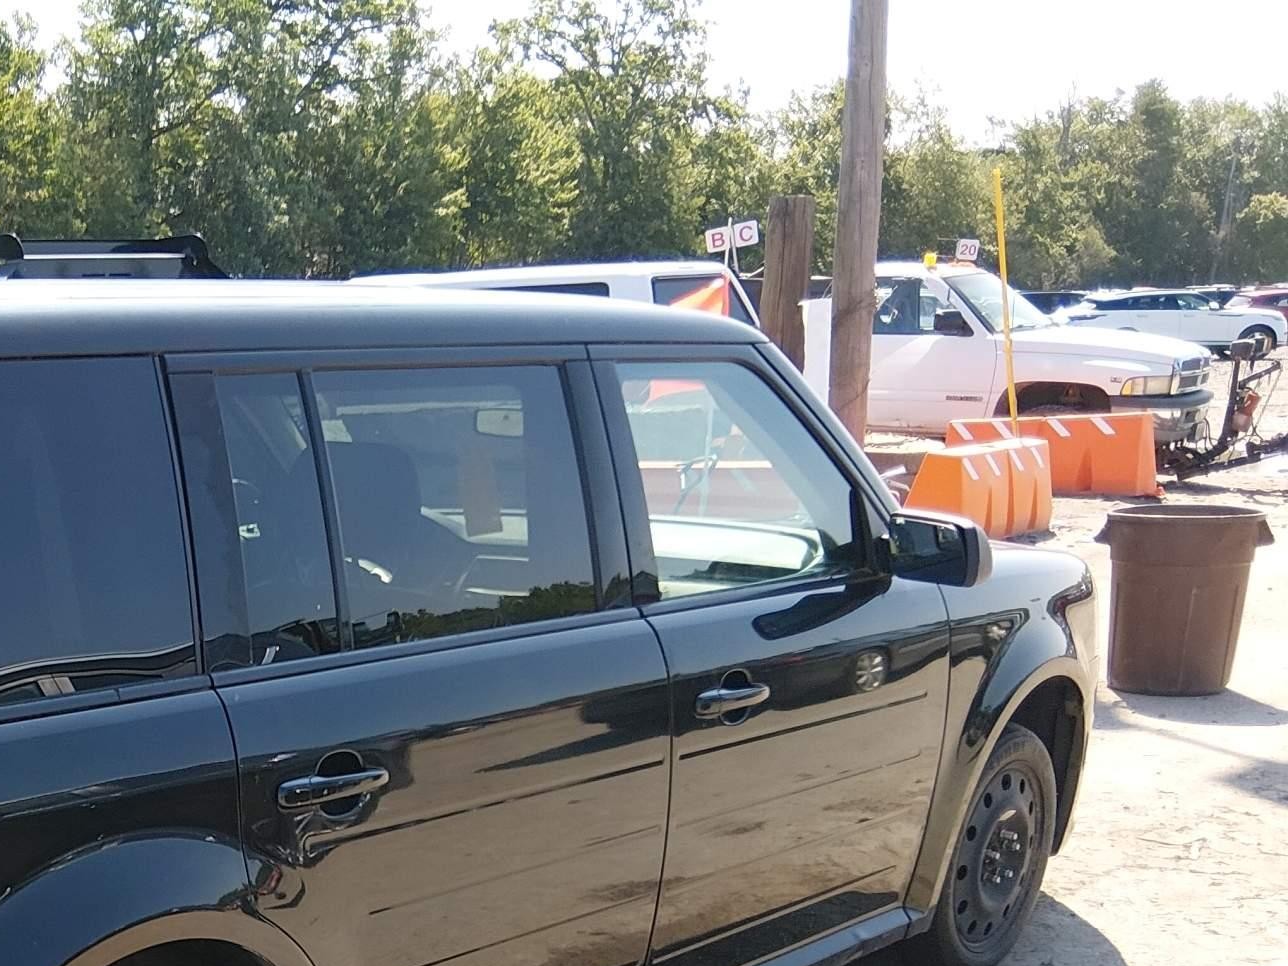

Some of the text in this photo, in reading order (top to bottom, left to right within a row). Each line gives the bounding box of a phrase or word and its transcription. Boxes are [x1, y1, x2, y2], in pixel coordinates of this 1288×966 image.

[711, 232, 725, 248] B
[739, 226, 753, 241] C
[960, 244, 977, 256] 20
